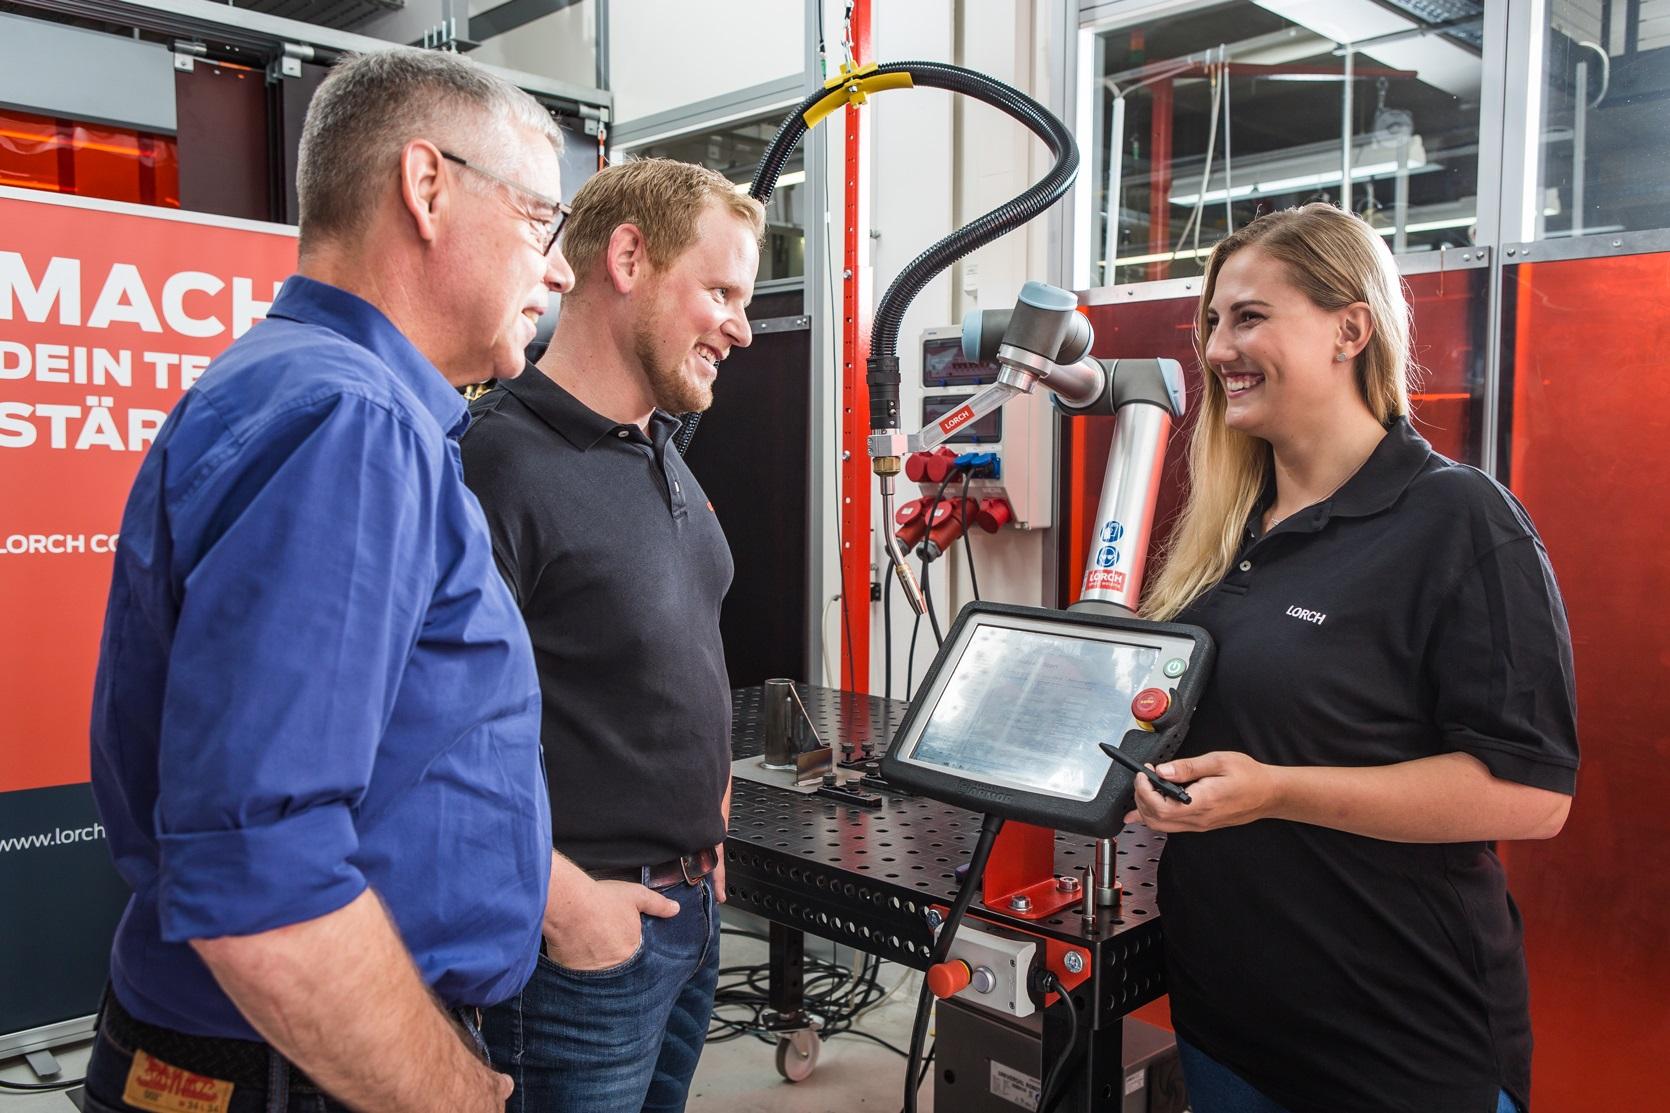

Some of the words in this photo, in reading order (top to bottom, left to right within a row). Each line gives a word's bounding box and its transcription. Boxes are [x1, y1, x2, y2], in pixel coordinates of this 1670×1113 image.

[0, 250, 284, 340] MACH
[0, 340, 132, 387] DEIN
[143, 351, 211, 391] TE
[0, 395, 168, 452] STÄR
[944, 410, 970, 430] LORCH
[1089, 571, 1122, 583] LORCH
[1286, 605, 1327, 625] LORCH
[0, 822, 106, 852] www.lorch
